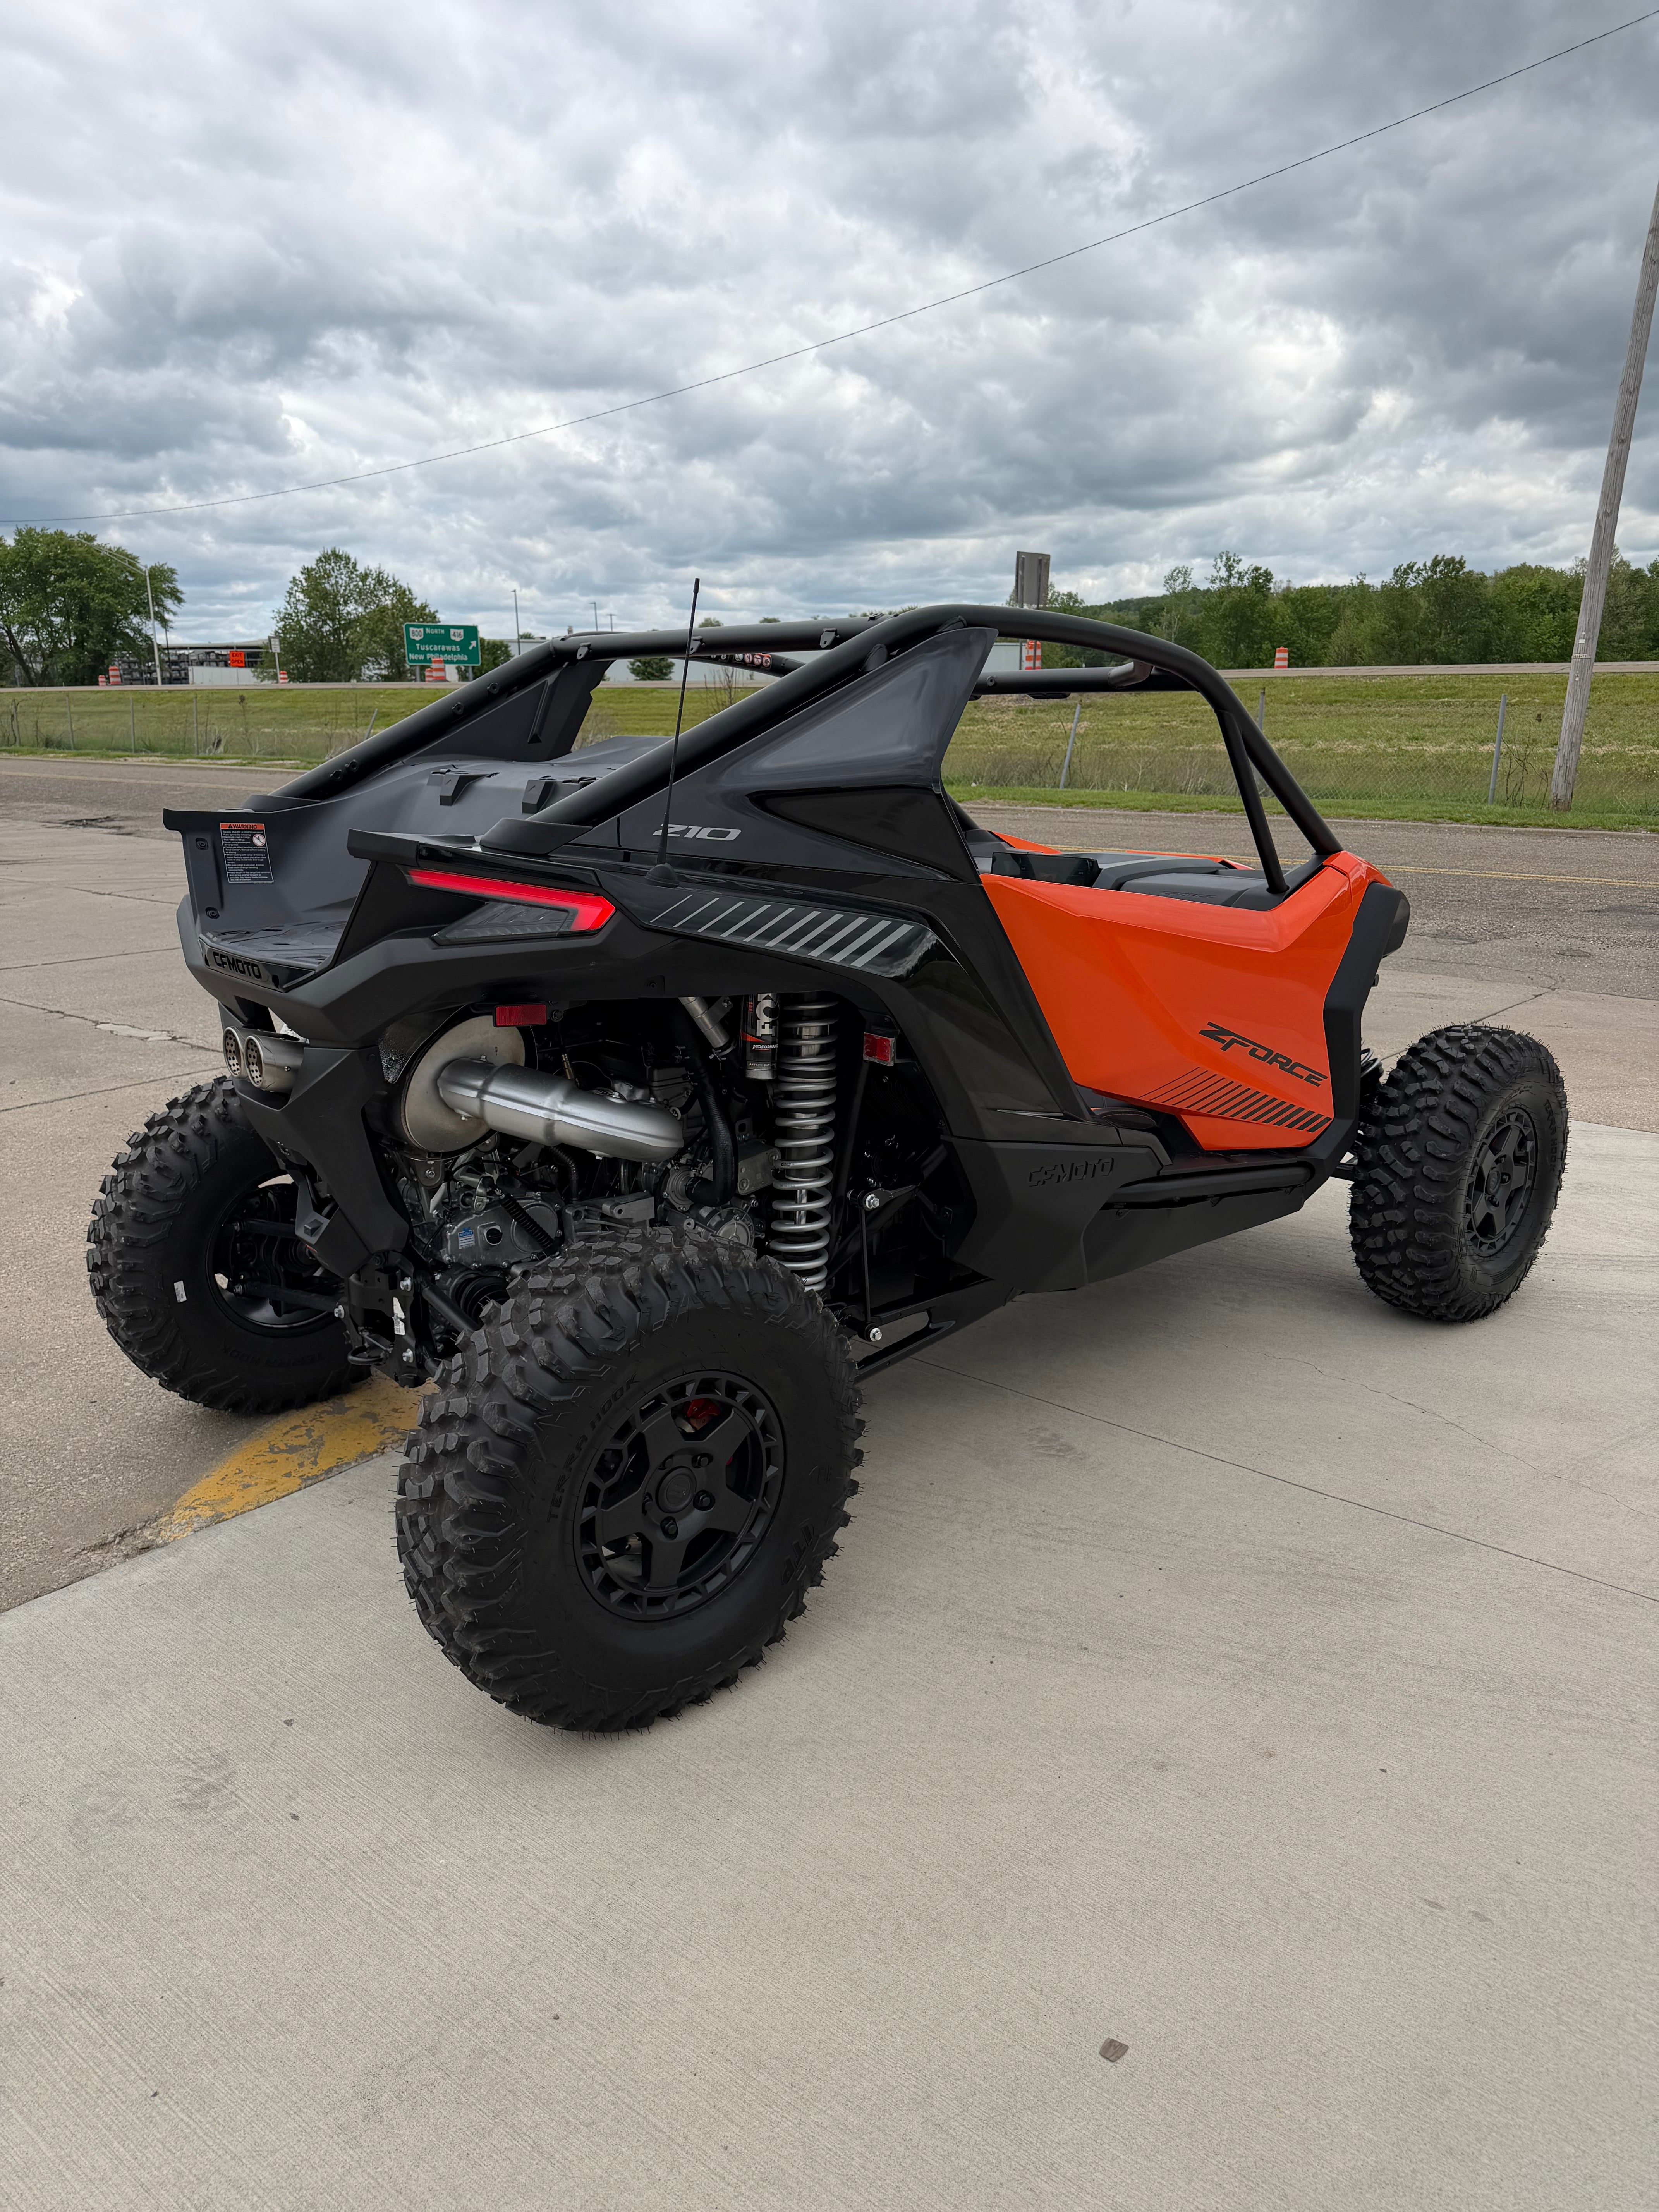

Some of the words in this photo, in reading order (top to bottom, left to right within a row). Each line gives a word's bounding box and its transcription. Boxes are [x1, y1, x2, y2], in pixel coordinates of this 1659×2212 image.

[213, 951, 262, 980] CFMOTO
[1199, 1021, 1328, 1087] ZFORCE
[1028, 1157, 1114, 1187] CFMOTO
[547, 1434, 588, 1523] TERRA
[589, 1372, 640, 1431] HOOK
